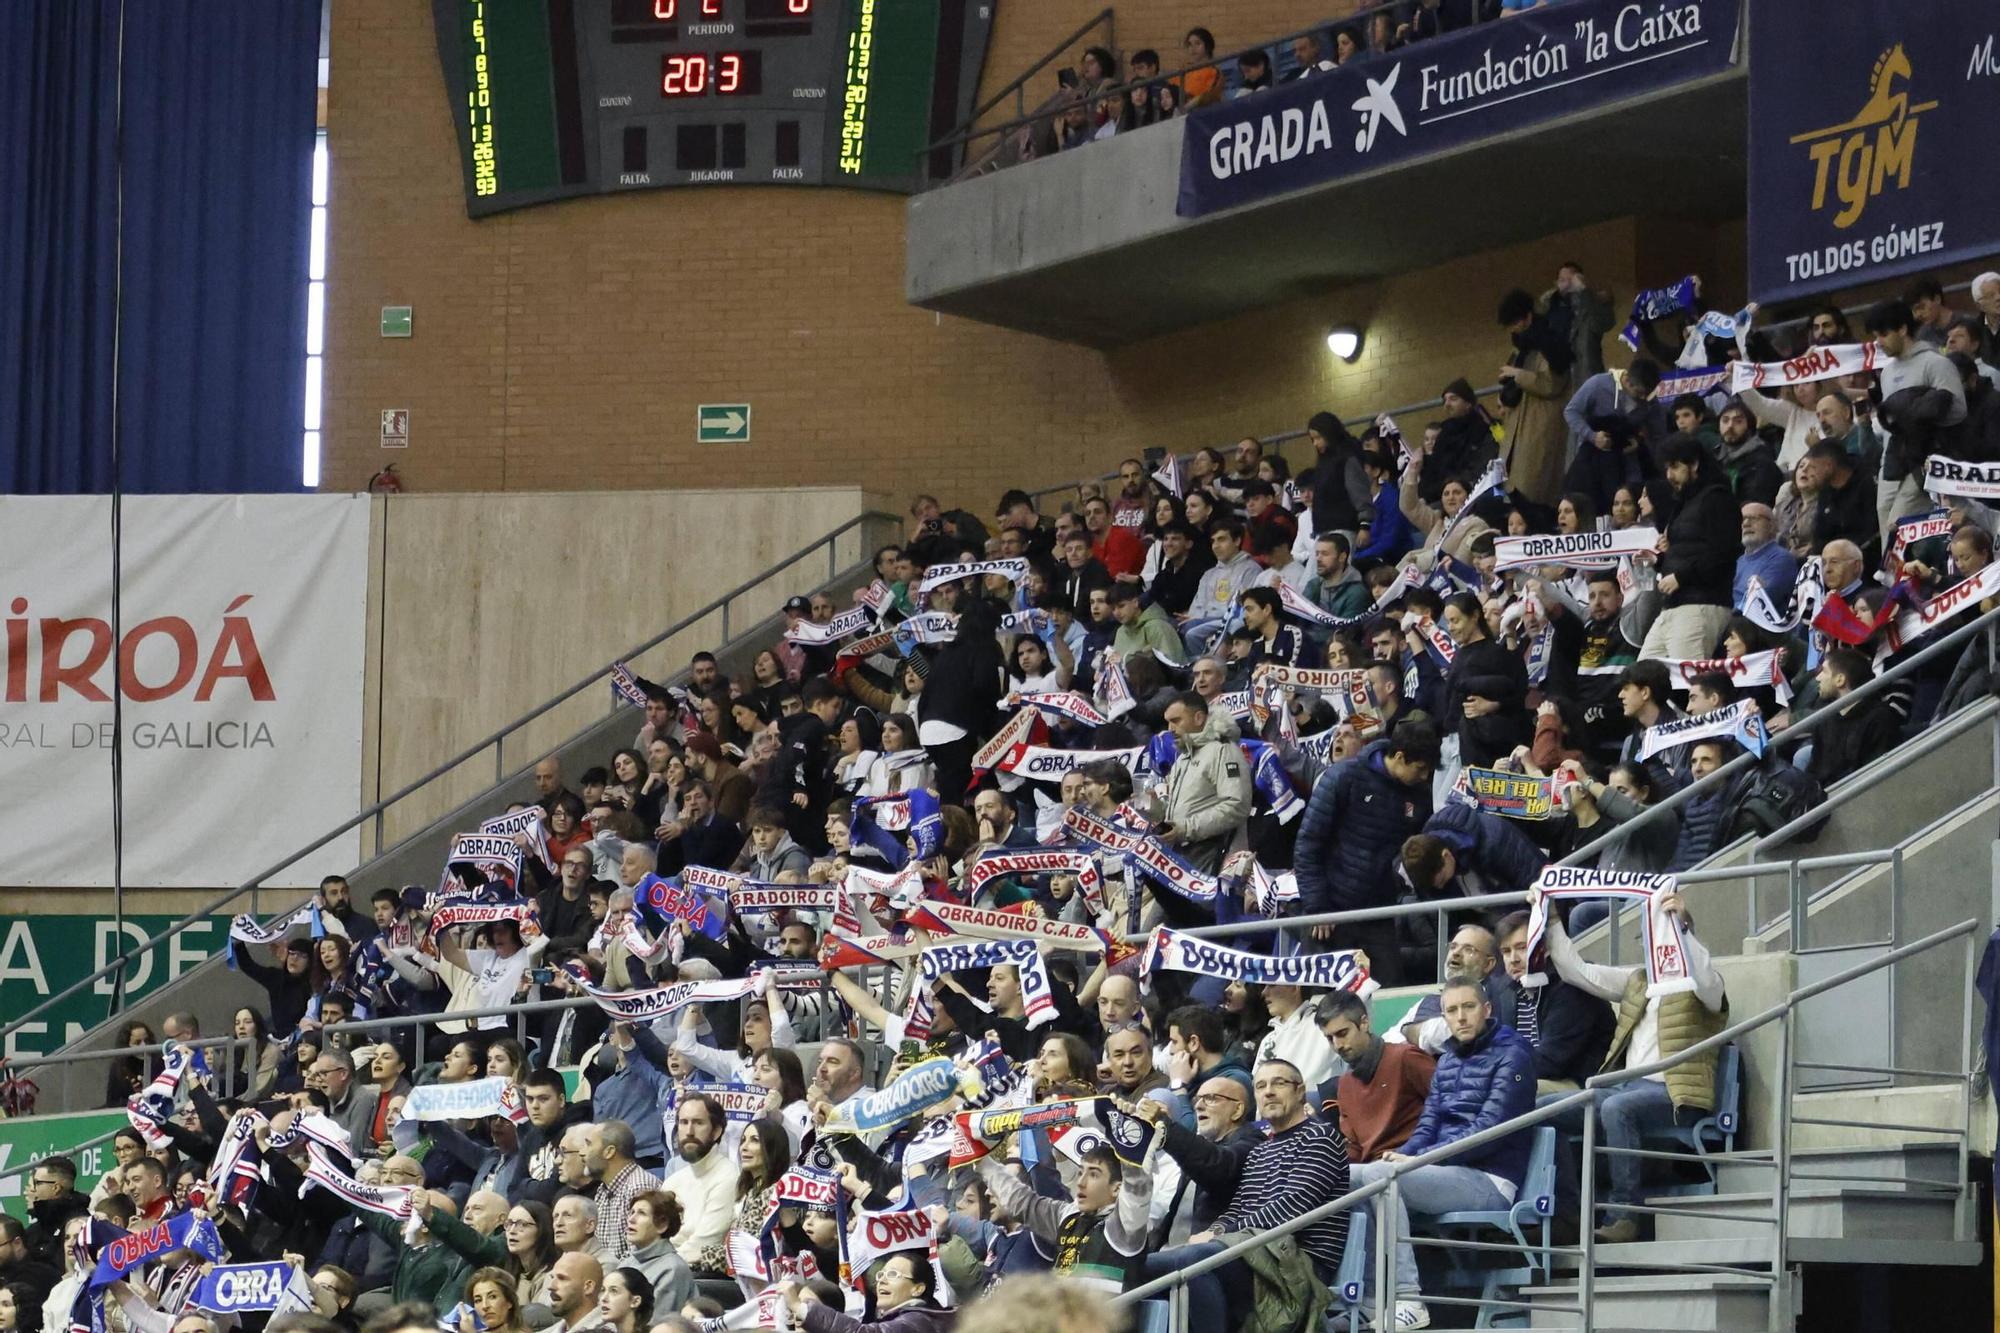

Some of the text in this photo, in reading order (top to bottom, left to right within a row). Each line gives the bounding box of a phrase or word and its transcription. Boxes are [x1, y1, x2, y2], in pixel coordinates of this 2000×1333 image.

[472, 19, 484, 37] 6
[688, 24, 735, 36] PERIODO
[861, 14, 873, 32] 9
[475, 37, 486, 54] 7
[850, 32, 871, 50] 10
[475, 54, 487, 72] 8
[848, 50, 870, 68] 13
[1420, 38, 1568, 111] Fundación
[1615, 2, 1702, 54] Caixa
[477, 71, 489, 90] 9
[846, 67, 869, 85] 14
[469, 89, 489, 107] 10
[845, 85, 867, 104] 20
[844, 103, 866, 121] 21
[472, 124, 493, 143] 13
[842, 121, 864, 139] 23
[841, 138, 863, 157] 31
[1210, 99, 1332, 181] GRADA
[473, 142, 494, 160] 26
[476, 159, 495, 178] 32
[772, 168, 803, 180] FALTAS
[840, 157, 861, 174] 44
[620, 173, 650, 185] FALTAS
[689, 170, 734, 182] JUGADOR
[476, 177, 497, 196] 93
[1786, 221, 1944, 282] TOLDOS GÓMEZ
[1783, 349, 1841, 382] OBRA
[1522, 533, 1613, 557] OBRADOIRO
[923, 561, 1026, 581] BRADOIRO
[72, 723, 115, 749] DE
[132, 720, 277, 749] GALICIA
[650, 882, 708, 929] OBRA
[938, 906, 1090, 939] OBRADOIRO C.A.B.
[745, 1085, 767, 1095] OBRA
[862, 1067, 950, 1119] OBRADOIRO
[1723, 1116, 1730, 1126] 8
[82, 1147, 103, 1176] DE
[1540, 1200, 1548, 1210] 7
[867, 1208, 932, 1249] OBRA
[109, 1219, 172, 1271] OBRA
[216, 1267, 283, 1308] OBRA
[1348, 1286, 1356, 1296] 6
